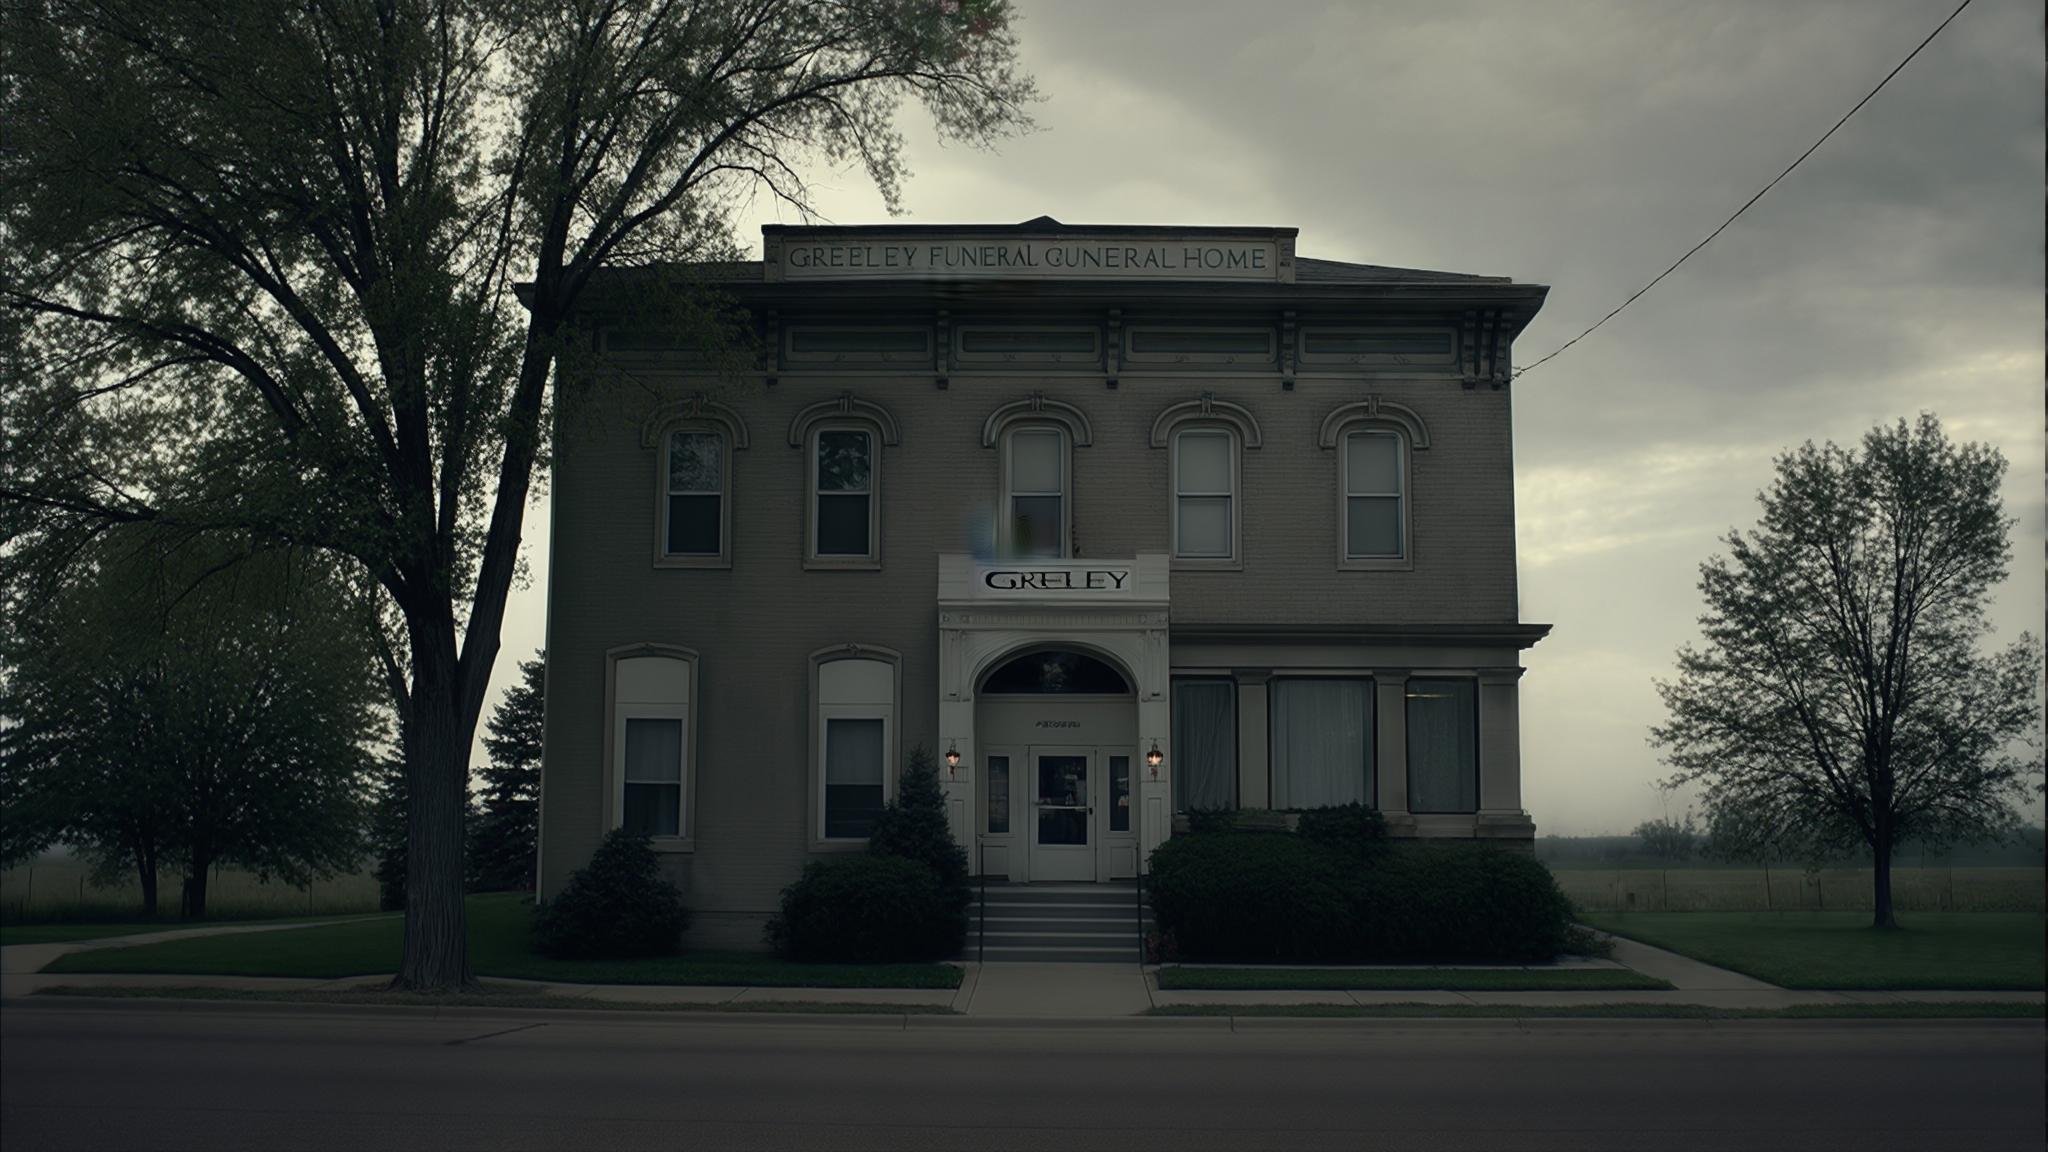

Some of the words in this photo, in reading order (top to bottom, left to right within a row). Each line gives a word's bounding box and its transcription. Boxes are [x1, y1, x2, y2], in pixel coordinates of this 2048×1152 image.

[790, 246, 918, 268] GREELEY
[930, 244, 1038, 268] FUNERAL
[1178, 247, 1268, 270] HOME
